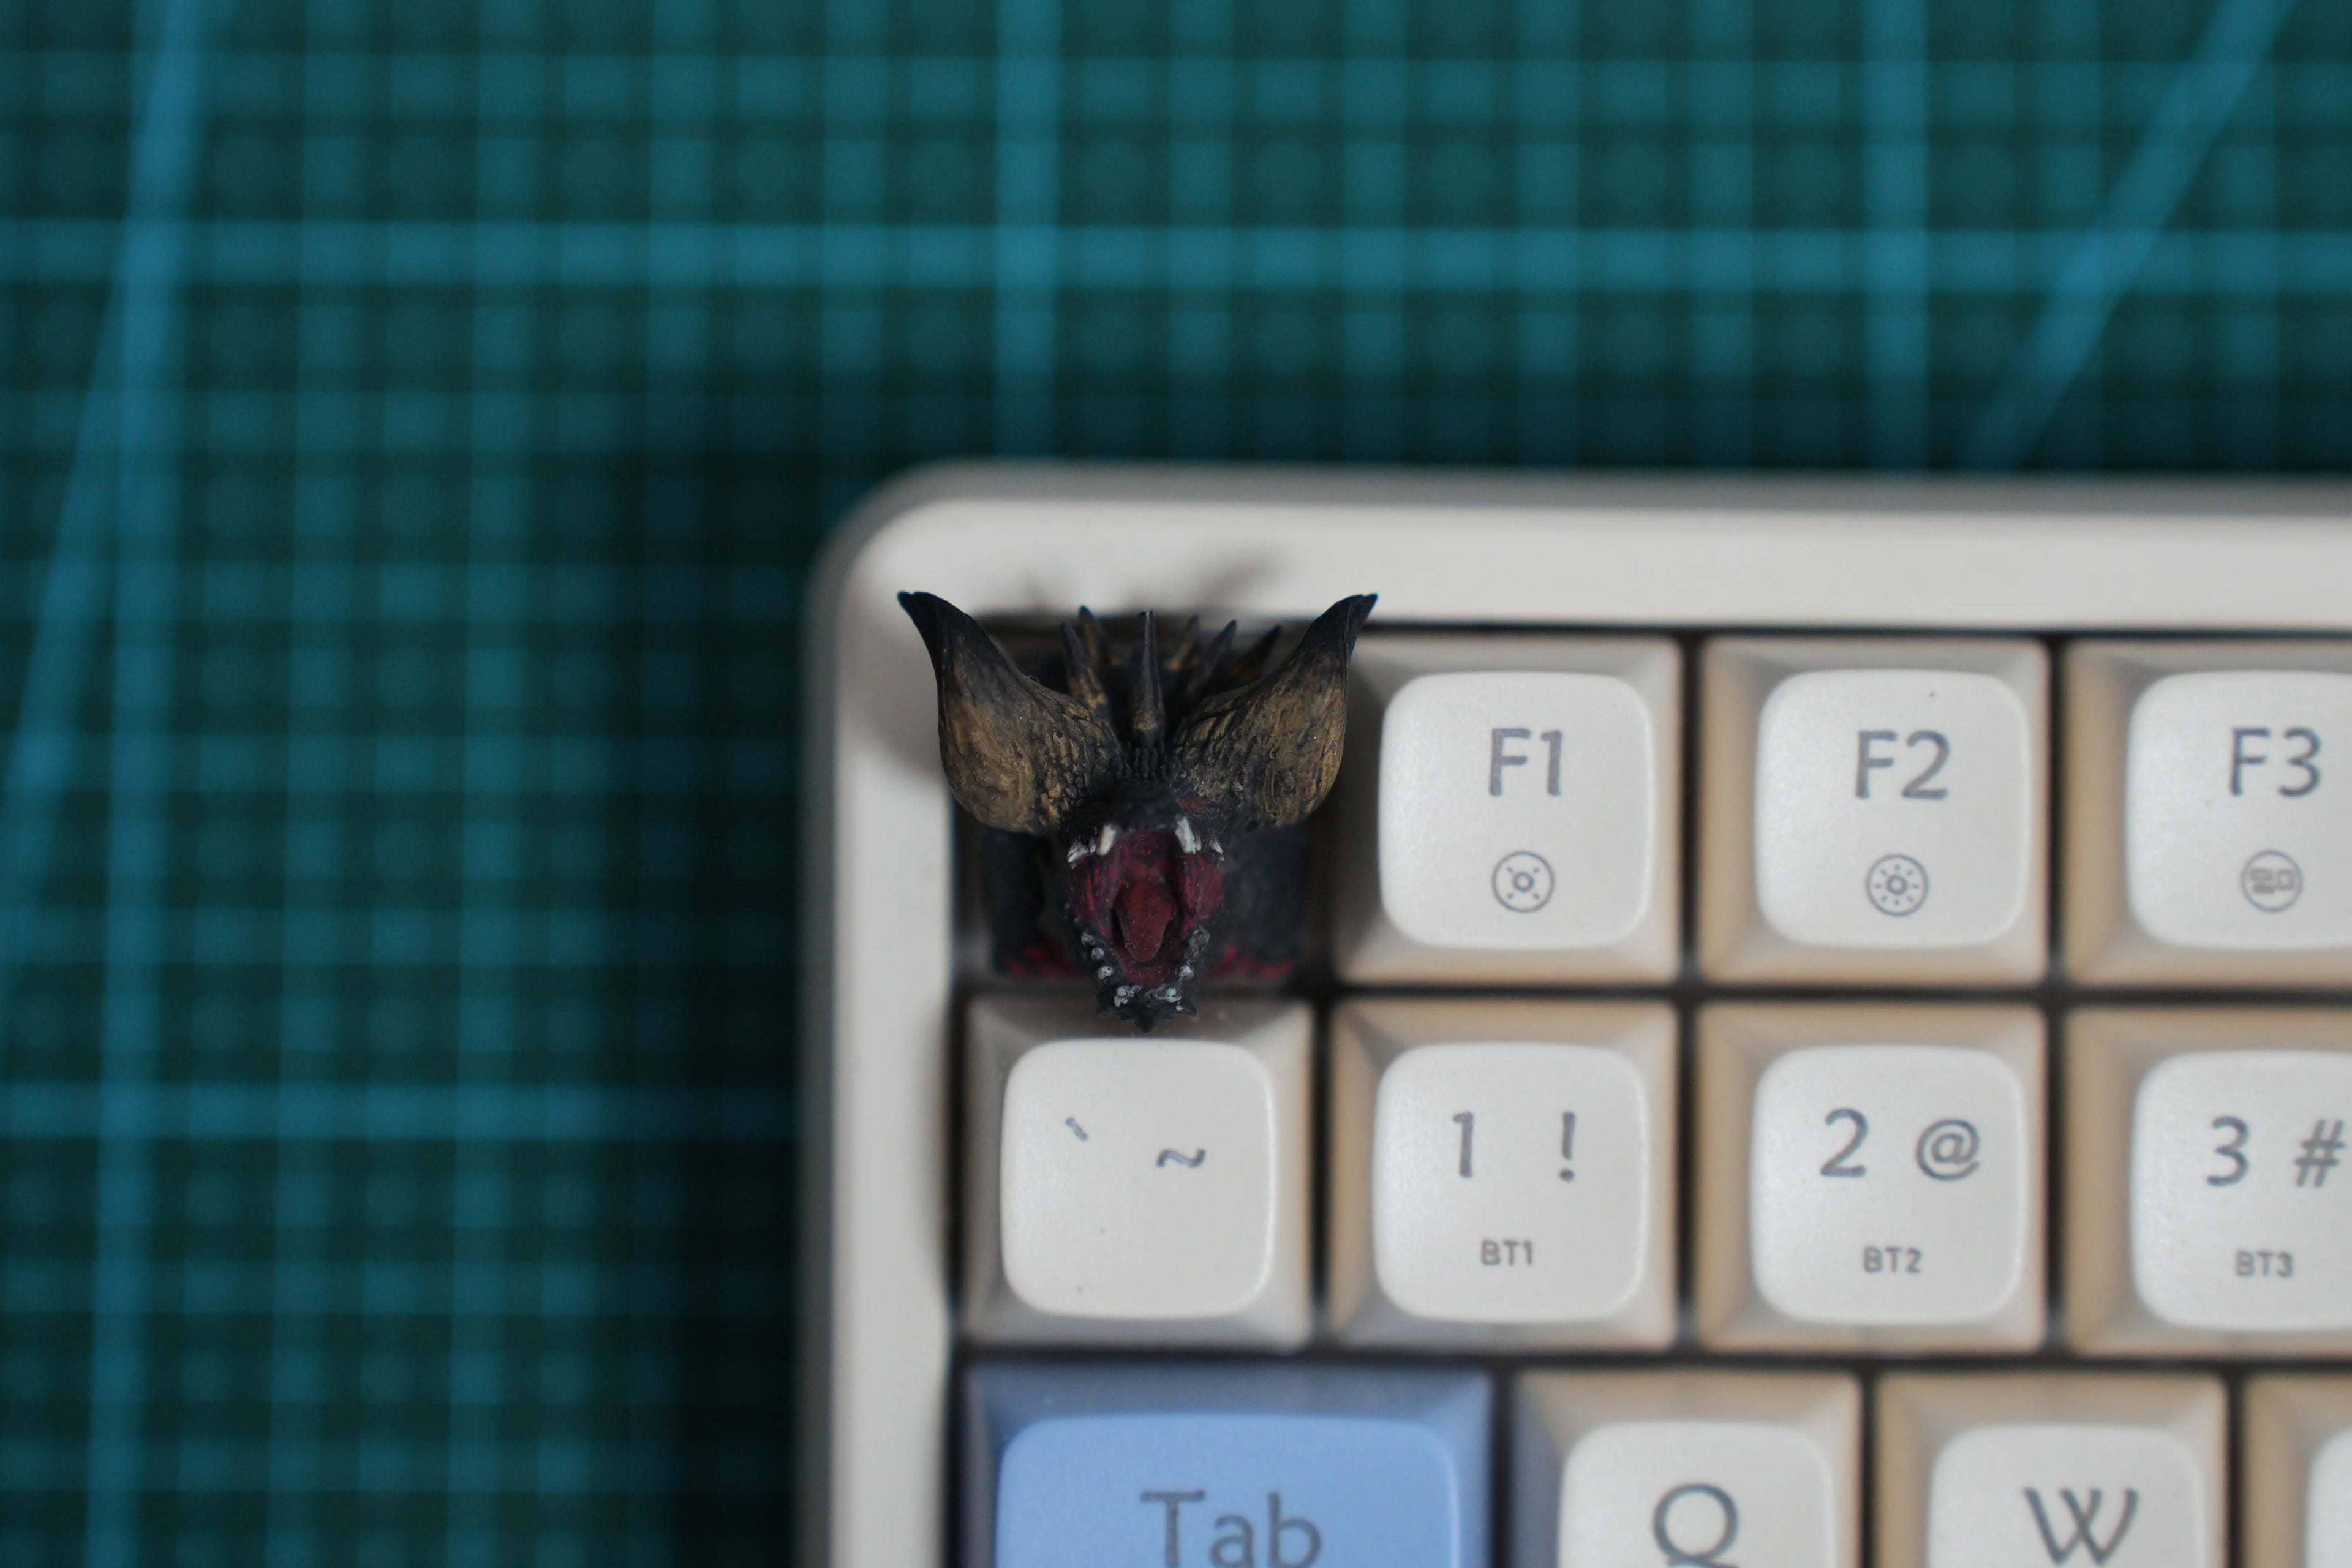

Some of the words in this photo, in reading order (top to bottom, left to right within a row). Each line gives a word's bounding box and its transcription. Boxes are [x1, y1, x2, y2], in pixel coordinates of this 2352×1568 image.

[1488, 726, 1564, 797] F1
[1854, 729, 1951, 802] F2
[2229, 726, 2323, 799] F3
[1155, 1148, 1207, 1169] ~
[1452, 1110, 1476, 1179] 1
[1558, 1110, 1577, 1183] !
[1819, 1107, 1869, 1178] 2
[1914, 1118, 1981, 1183] @
[2206, 1115, 2250, 1188] 3
[2293, 1118, 2347, 1188] #
[1480, 1238, 1534, 1267] BT1
[1862, 1245, 1923, 1275] BT2
[2235, 1249, 2294, 1279] BT3
[1140, 1490, 1322, 1568] Tab
[1653, 1483, 1741, 1568] Q
[2024, 1487, 2139, 1567] W
